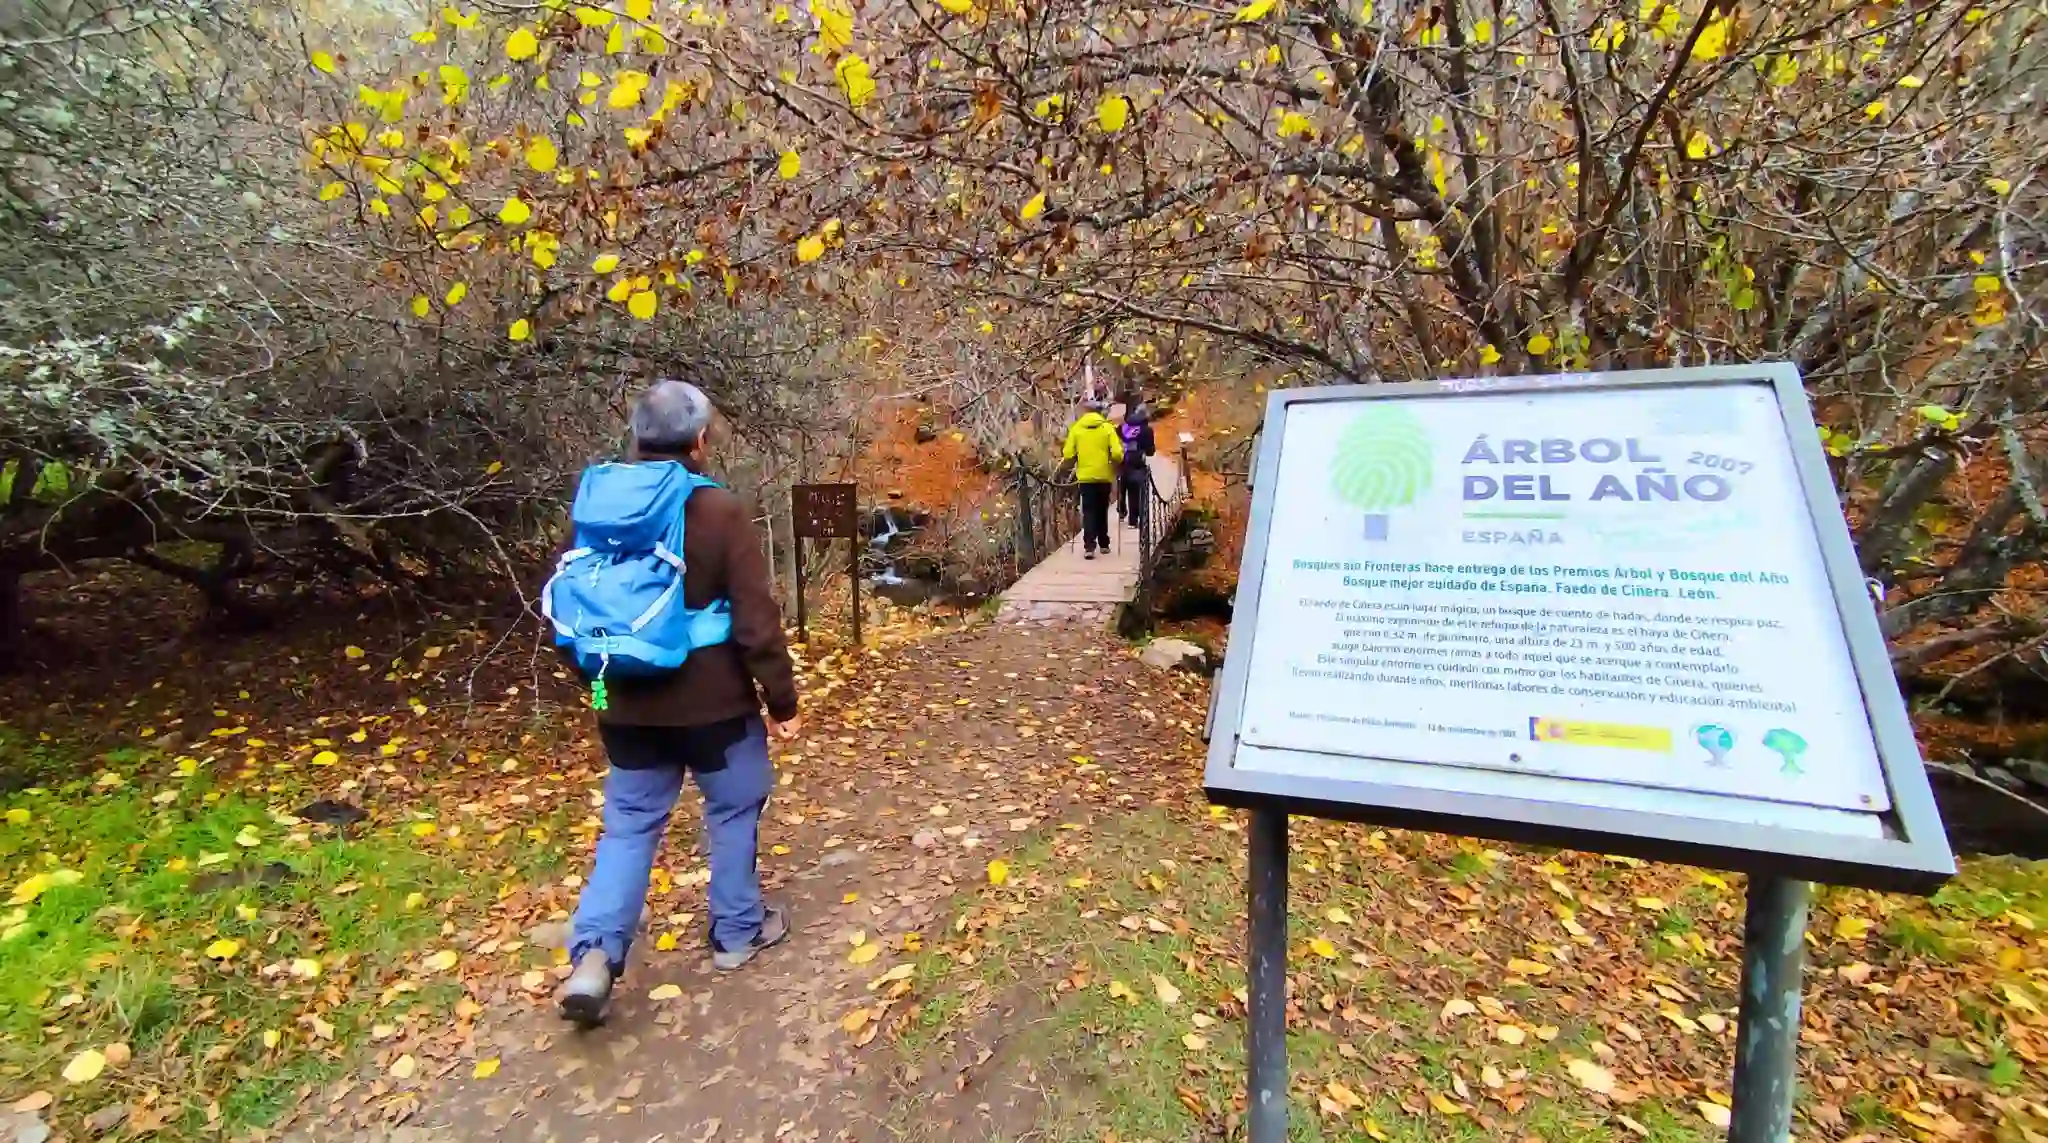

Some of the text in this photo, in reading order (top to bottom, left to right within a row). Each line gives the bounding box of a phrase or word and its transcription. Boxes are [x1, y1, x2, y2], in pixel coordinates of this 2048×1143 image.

[1461, 433, 1661, 464] ÁRBOL
[1687, 450, 1755, 475] 2007
[1463, 467, 1732, 502] DEL AÑO
[1462, 528, 1565, 545] ESPAÑA
[1293, 559, 1340, 572] Bosques
[1365, 561, 1421, 572] Fronteras
[1425, 562, 1454, 573] hace
[1458, 563, 1506, 576] entrega
[1510, 564, 1525, 575] de
[1529, 565, 1549, 576] los
[1553, 565, 1610, 578] Premios
[1614, 564, 1652, 579] Árbol
[1657, 571, 1665, 582] y
[1668, 568, 1725, 584] Bosque
[1730, 571, 1754, 583] del
[1759, 571, 1789, 584] Año
[1343, 576, 1388, 589] Bosque
[1390, 577, 1425, 590] mejor
[1427, 578, 1477, 591] cuidado
[1480, 580, 1497, 591] de
[1556, 582, 1596, 595] Faedo
[1601, 583, 1617, 596] de
[1412, 603, 1437, 615] lugar
[1498, 606, 1537, 619] bosque
[1540, 608, 1552, 617] de
[1555, 609, 1592, 619] cuento
[1596, 610, 1609, 619] de
[1654, 612, 1691, 624] donde
[1695, 615, 1708, 624] se
[1549, 622, 1608, 635] naturaleza
[1611, 626, 1625, 636] es
[1628, 626, 1637, 637] el
[1641, 628, 1669, 640] haya
[1673, 629, 1688, 640] de
[1553, 637, 1567, 648] de
[1604, 642, 1611, 653] y
[1671, 644, 1686, 655] de
[1494, 649, 1519, 660] todo
[1523, 651, 1552, 664] aquel
[1556, 653, 1577, 665] que
[1580, 655, 1592, 665] se
[1595, 656, 1641, 669] acerque
[1560, 669, 1577, 680] los
[1646, 675, 1661, 686] de
[1508, 681, 1548, 694] labores
[1551, 684, 1565, 695] de
[1648, 692, 1656, 704] y
[1727, 698, 1797, 713] ambiental
